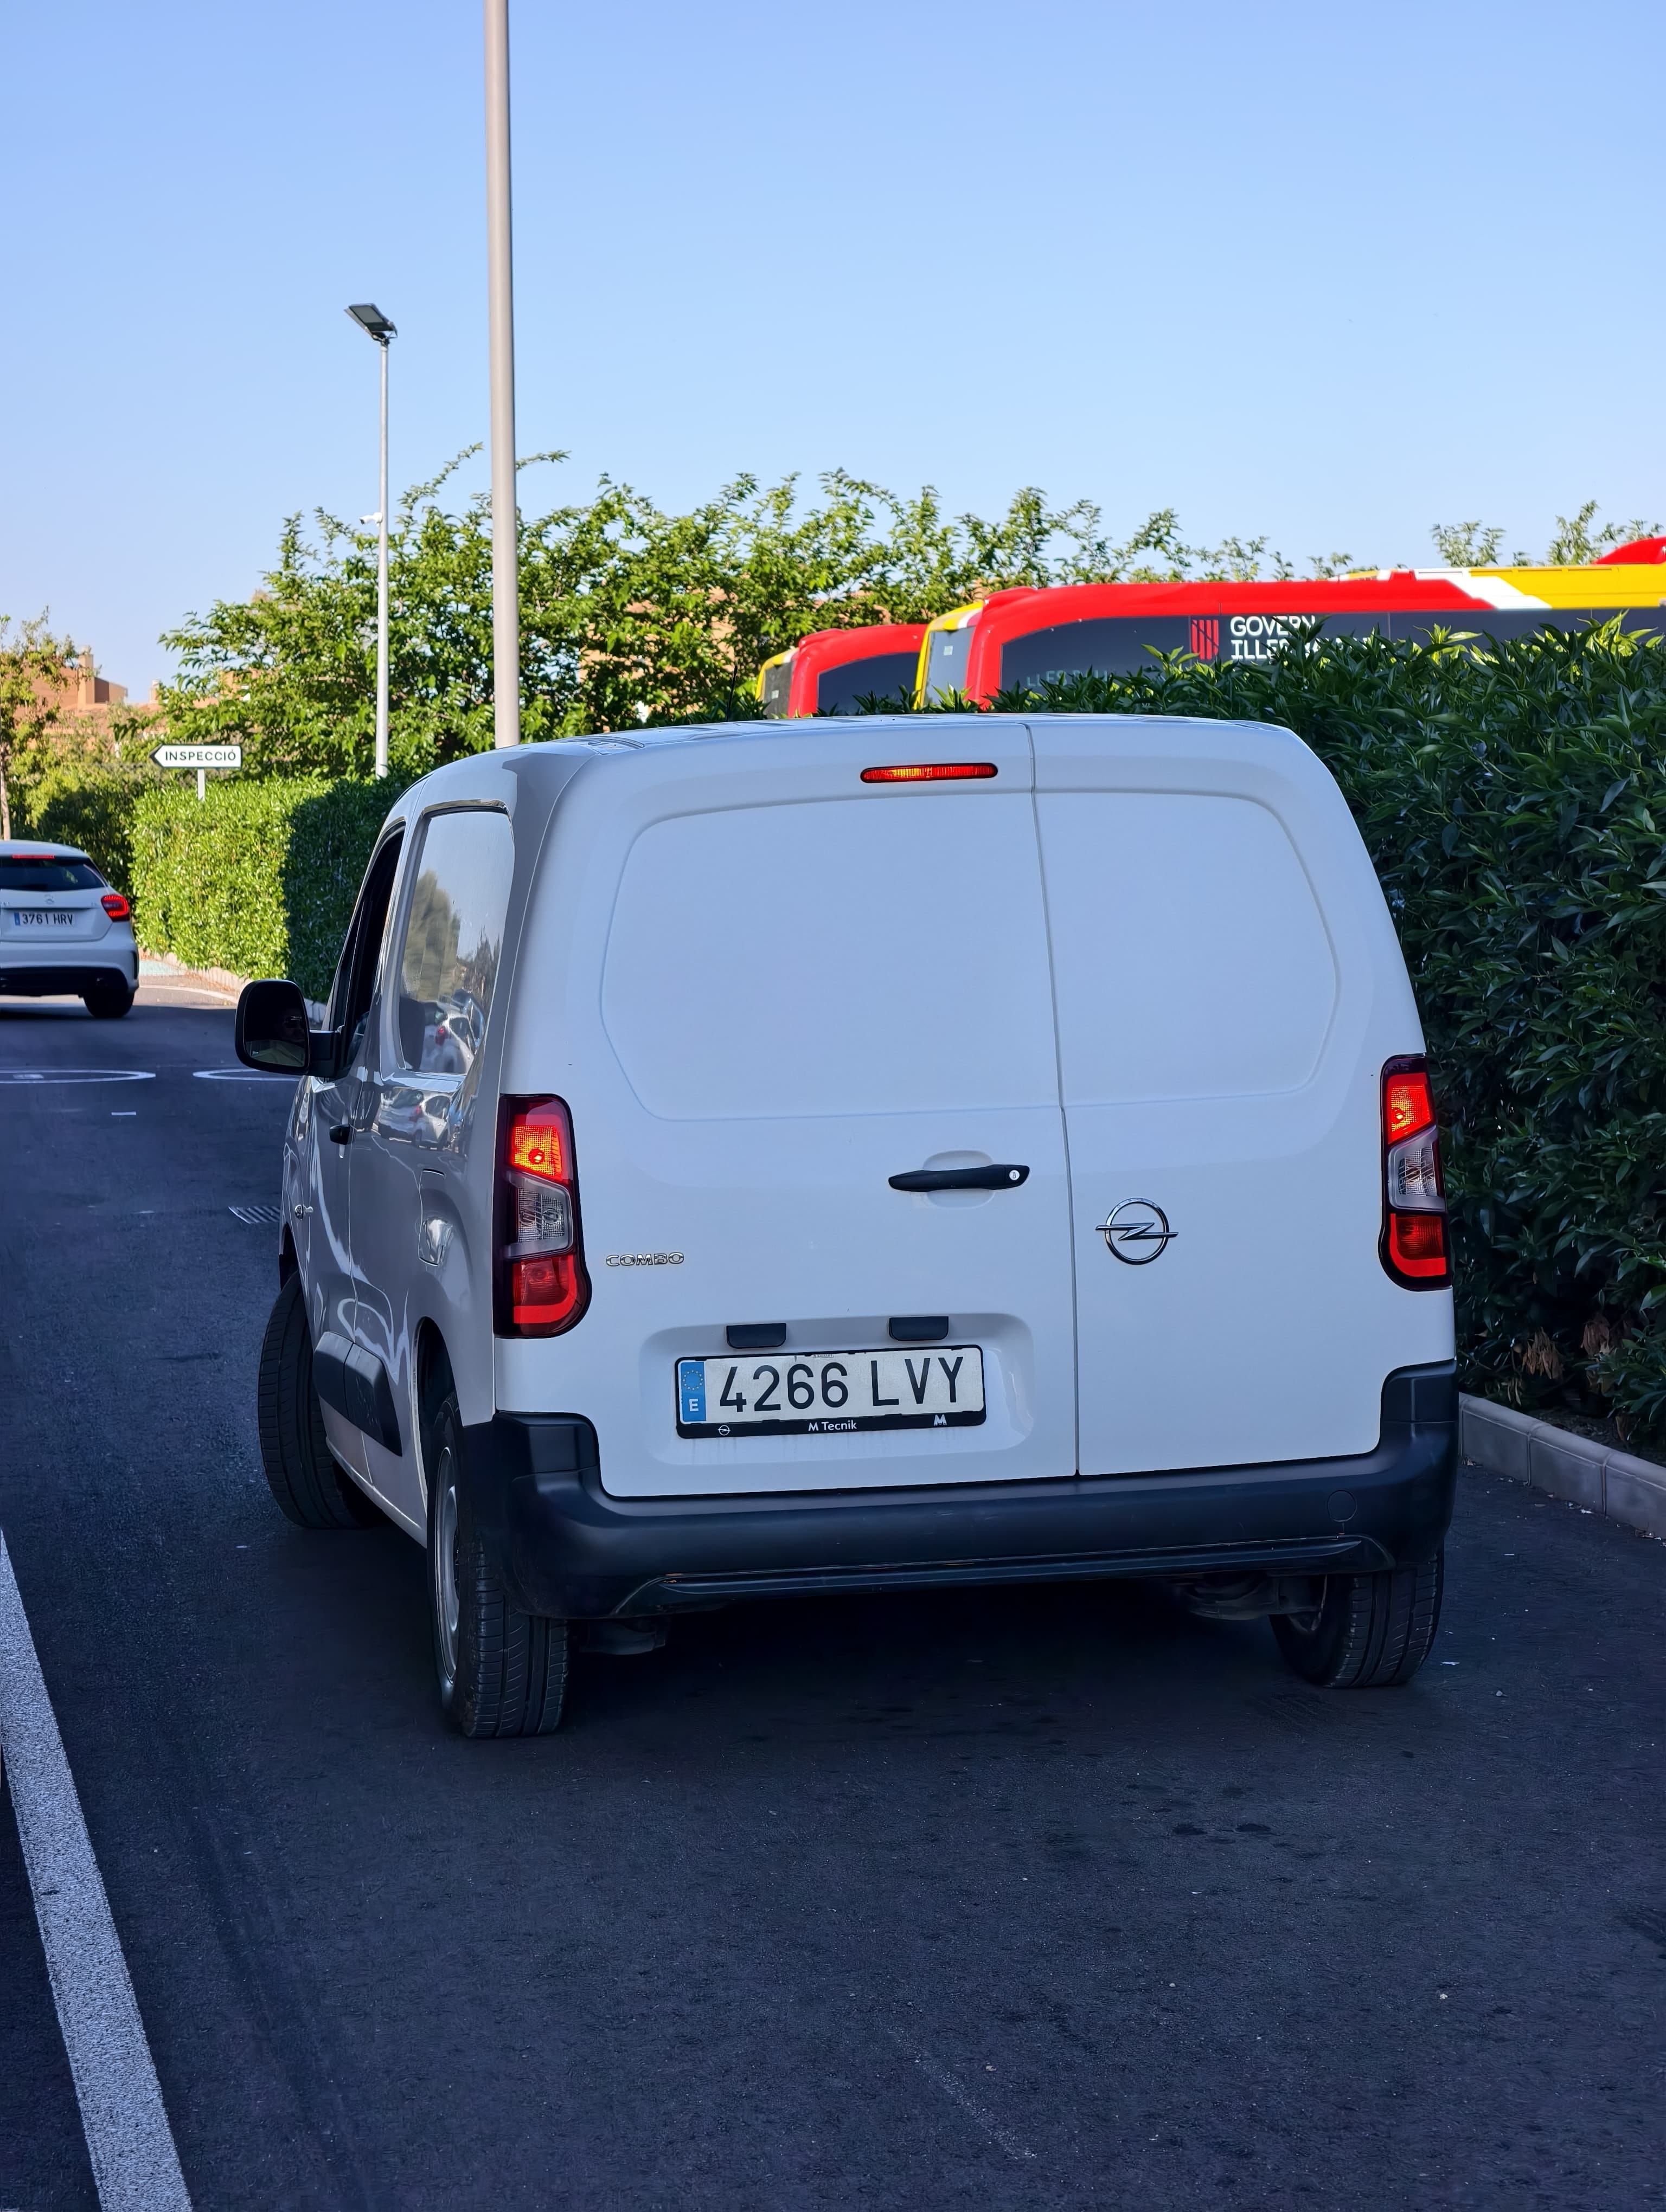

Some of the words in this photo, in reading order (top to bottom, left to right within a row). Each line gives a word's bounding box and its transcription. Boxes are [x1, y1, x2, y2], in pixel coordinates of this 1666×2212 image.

[165, 749, 236, 761] INSPECCIÓ
[22, 913, 49, 925] 3761
[54, 913, 73, 925] HRV
[606, 1252, 684, 1267] COMBO
[689, 1398, 699, 1412] E
[720, 1362, 849, 1412] 4266
[870, 1356, 964, 1406] LVY
[808, 1422, 819, 1432] M
[821, 1419, 857, 1431] Tecnik
